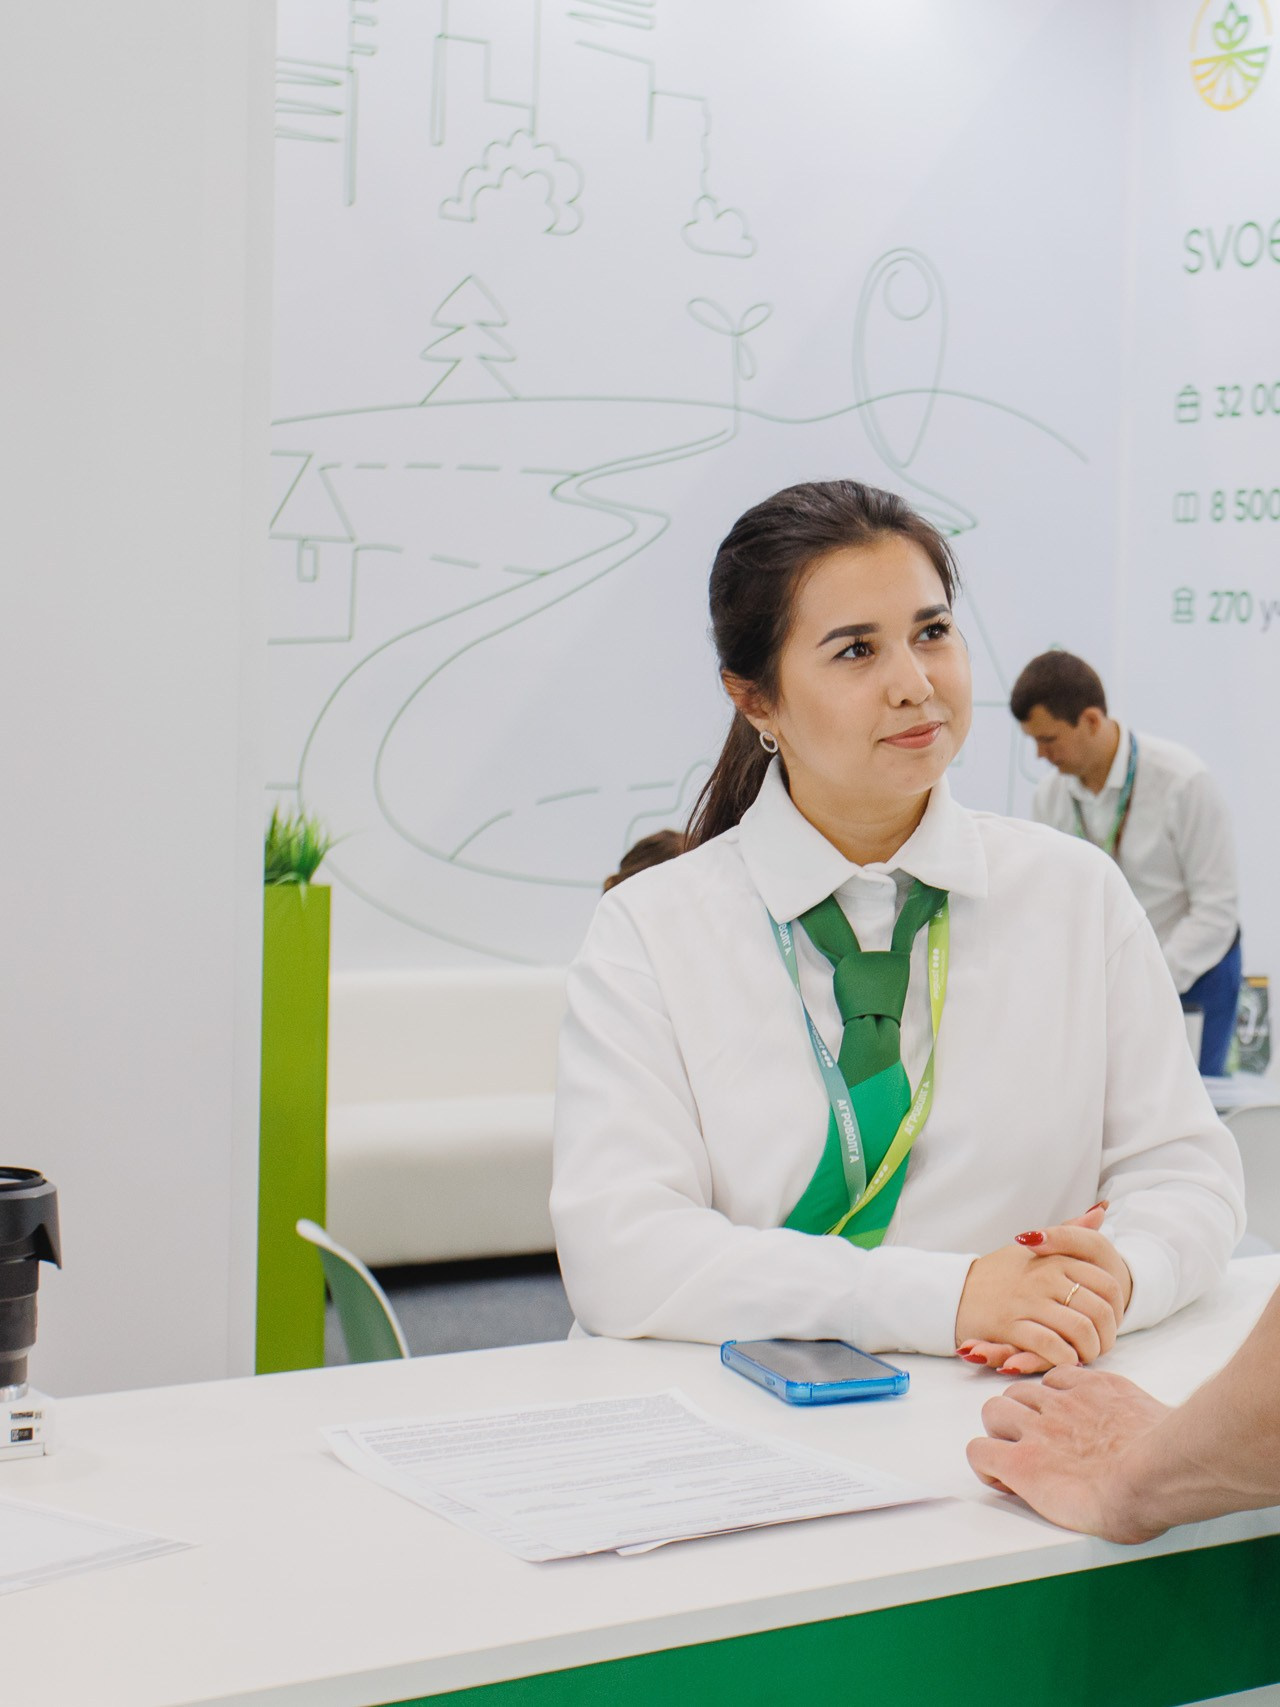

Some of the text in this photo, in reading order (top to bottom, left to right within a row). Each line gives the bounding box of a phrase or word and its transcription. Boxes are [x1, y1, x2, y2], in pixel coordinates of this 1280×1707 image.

[1214, 385, 1243, 418] 32
[1210, 490, 1226, 523] 8
[1208, 591, 1252, 624] 270
[904, 1081, 930, 1137] АГРОВОЛГА
[837, 1099, 860, 1164] АГРОВОЛГА
